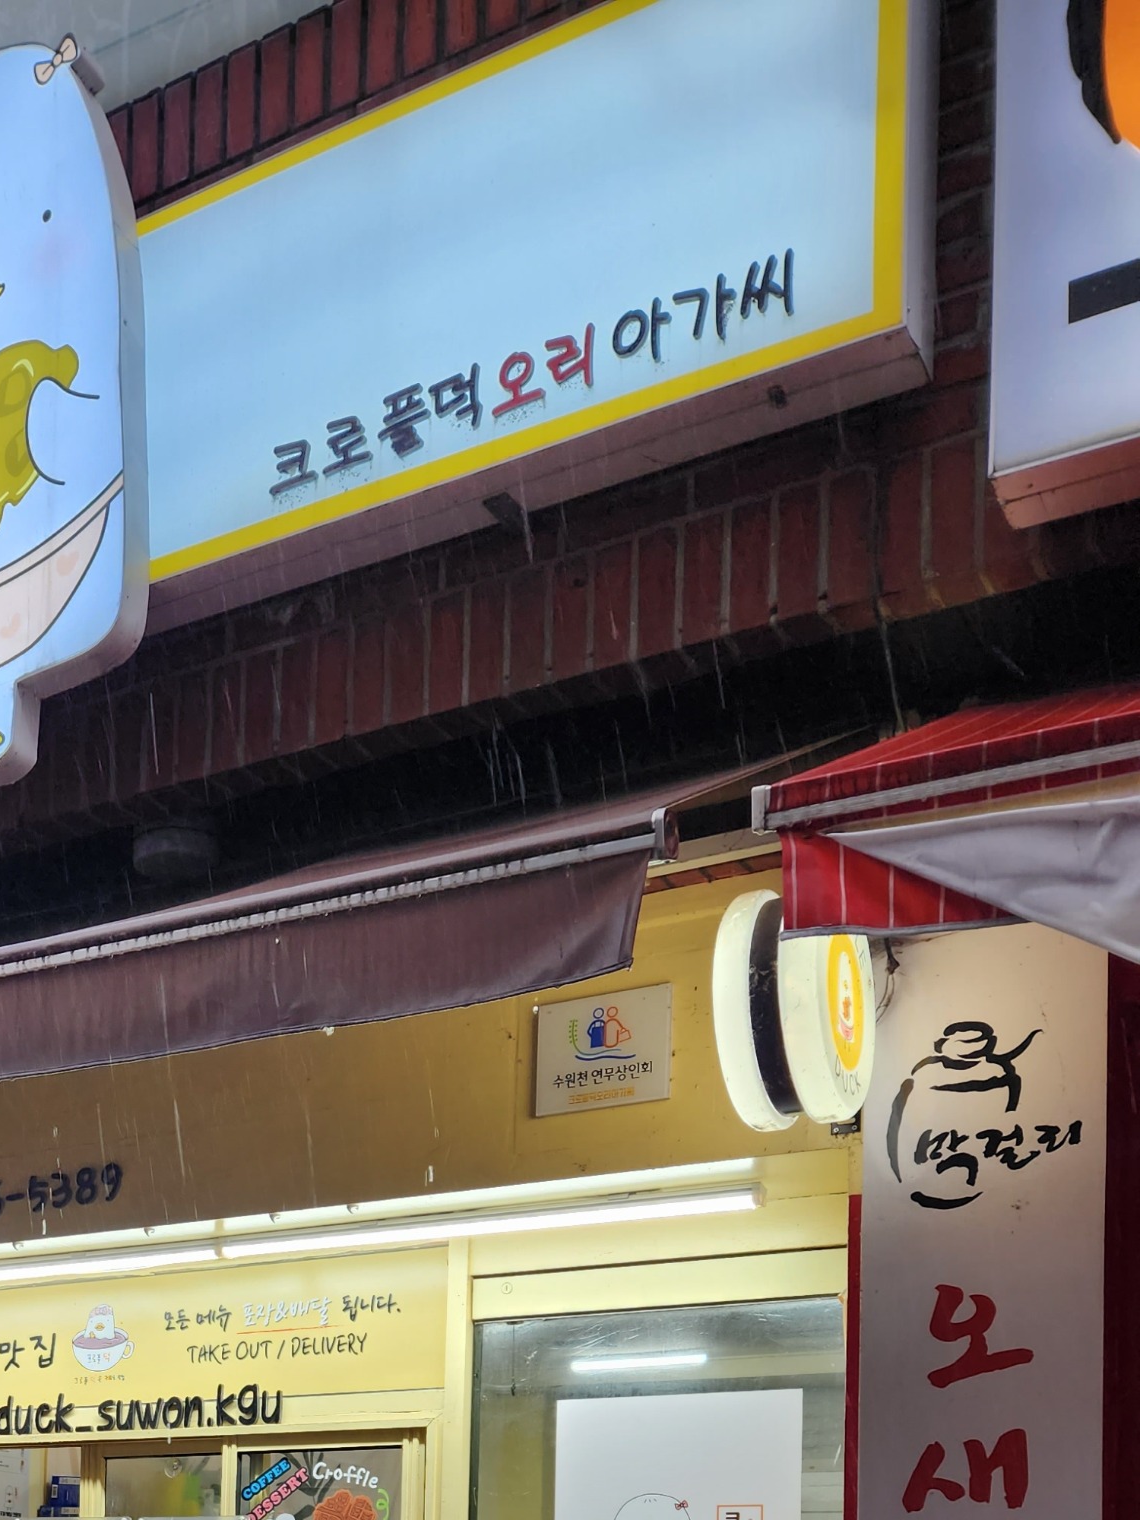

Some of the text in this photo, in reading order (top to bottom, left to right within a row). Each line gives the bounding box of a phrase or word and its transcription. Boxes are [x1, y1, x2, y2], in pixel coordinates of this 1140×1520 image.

[612, 248, 794, 363] 아가씨
[553, 1061, 654, 1090] 수원천 연무상인회
[834, 1053, 861, 1096] DUCK
[914, 1118, 1083, 1187] 막걸리
[164, 1293, 401, 1332] 모든 메뉴 포장&배달 됩니다.
[0, 1333, 56, 1371] 맛집
[187, 1345, 231, 1364] TAKE
[235, 1340, 273, 1360] OUT
[291, 1332, 368, 1357] DELIVERY
[242, 1458, 291, 1501] COFFEE
[312, 1461, 379, 1489] Croffle
